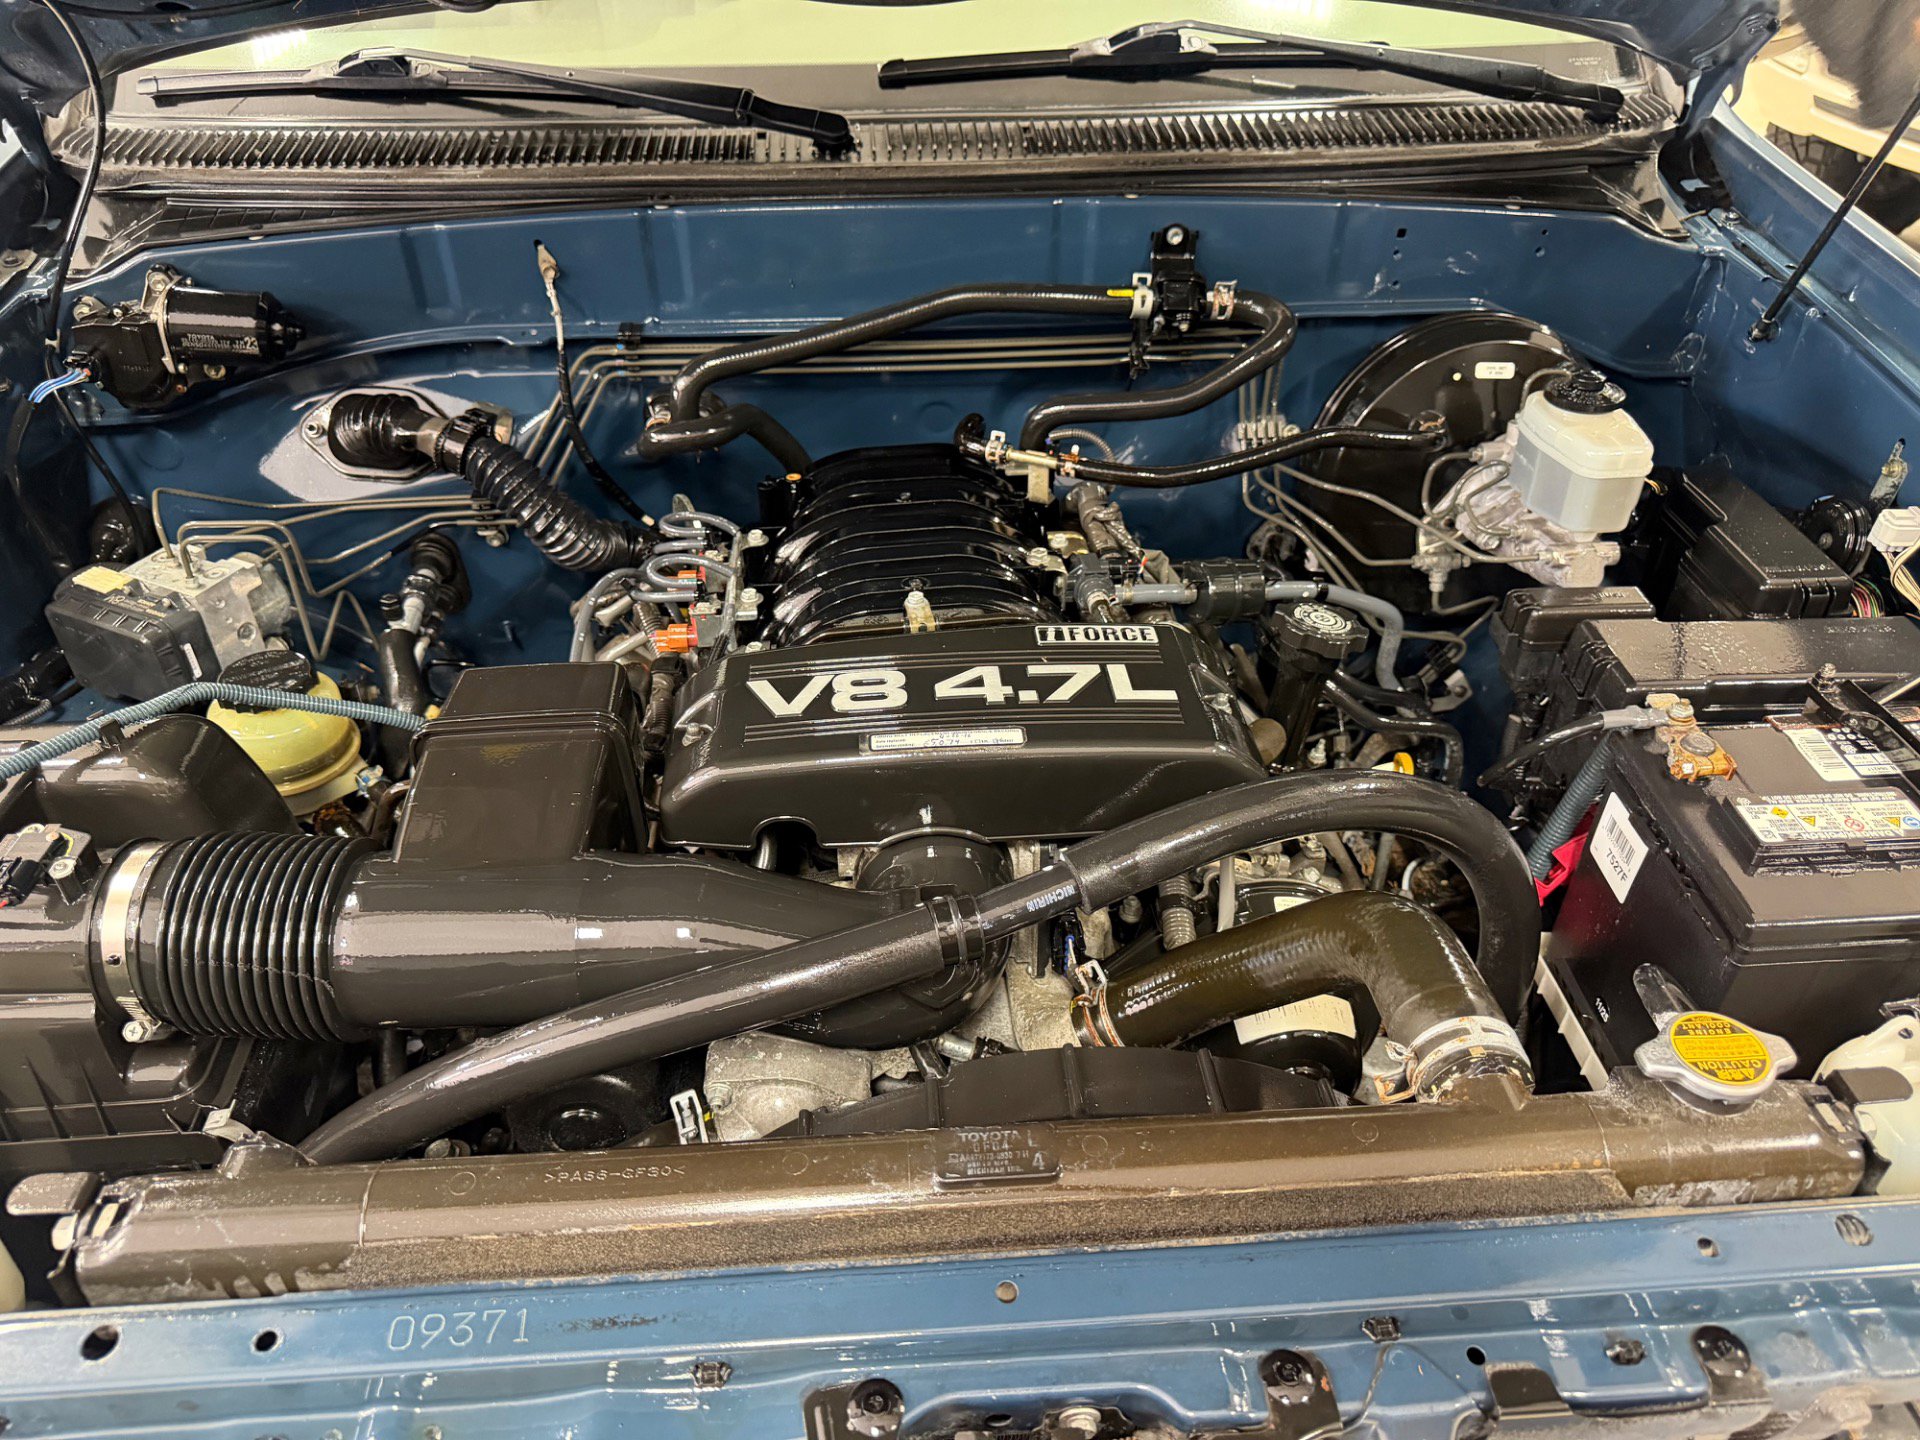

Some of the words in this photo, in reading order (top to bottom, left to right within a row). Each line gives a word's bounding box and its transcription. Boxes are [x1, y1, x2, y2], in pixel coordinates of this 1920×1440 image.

[186, 333, 216, 341] TOYOTA
[746, 669, 908, 718] V8
[934, 664, 1180, 705] 4.7L
[1606, 847, 1628, 881] 7527F
[1026, 884, 1076, 912] NICHIRIN
[1697, 1059, 1762, 1071] CAUTION
[957, 1130, 1021, 1143] TOYOTA
[387, 1308, 530, 1351] 09371
